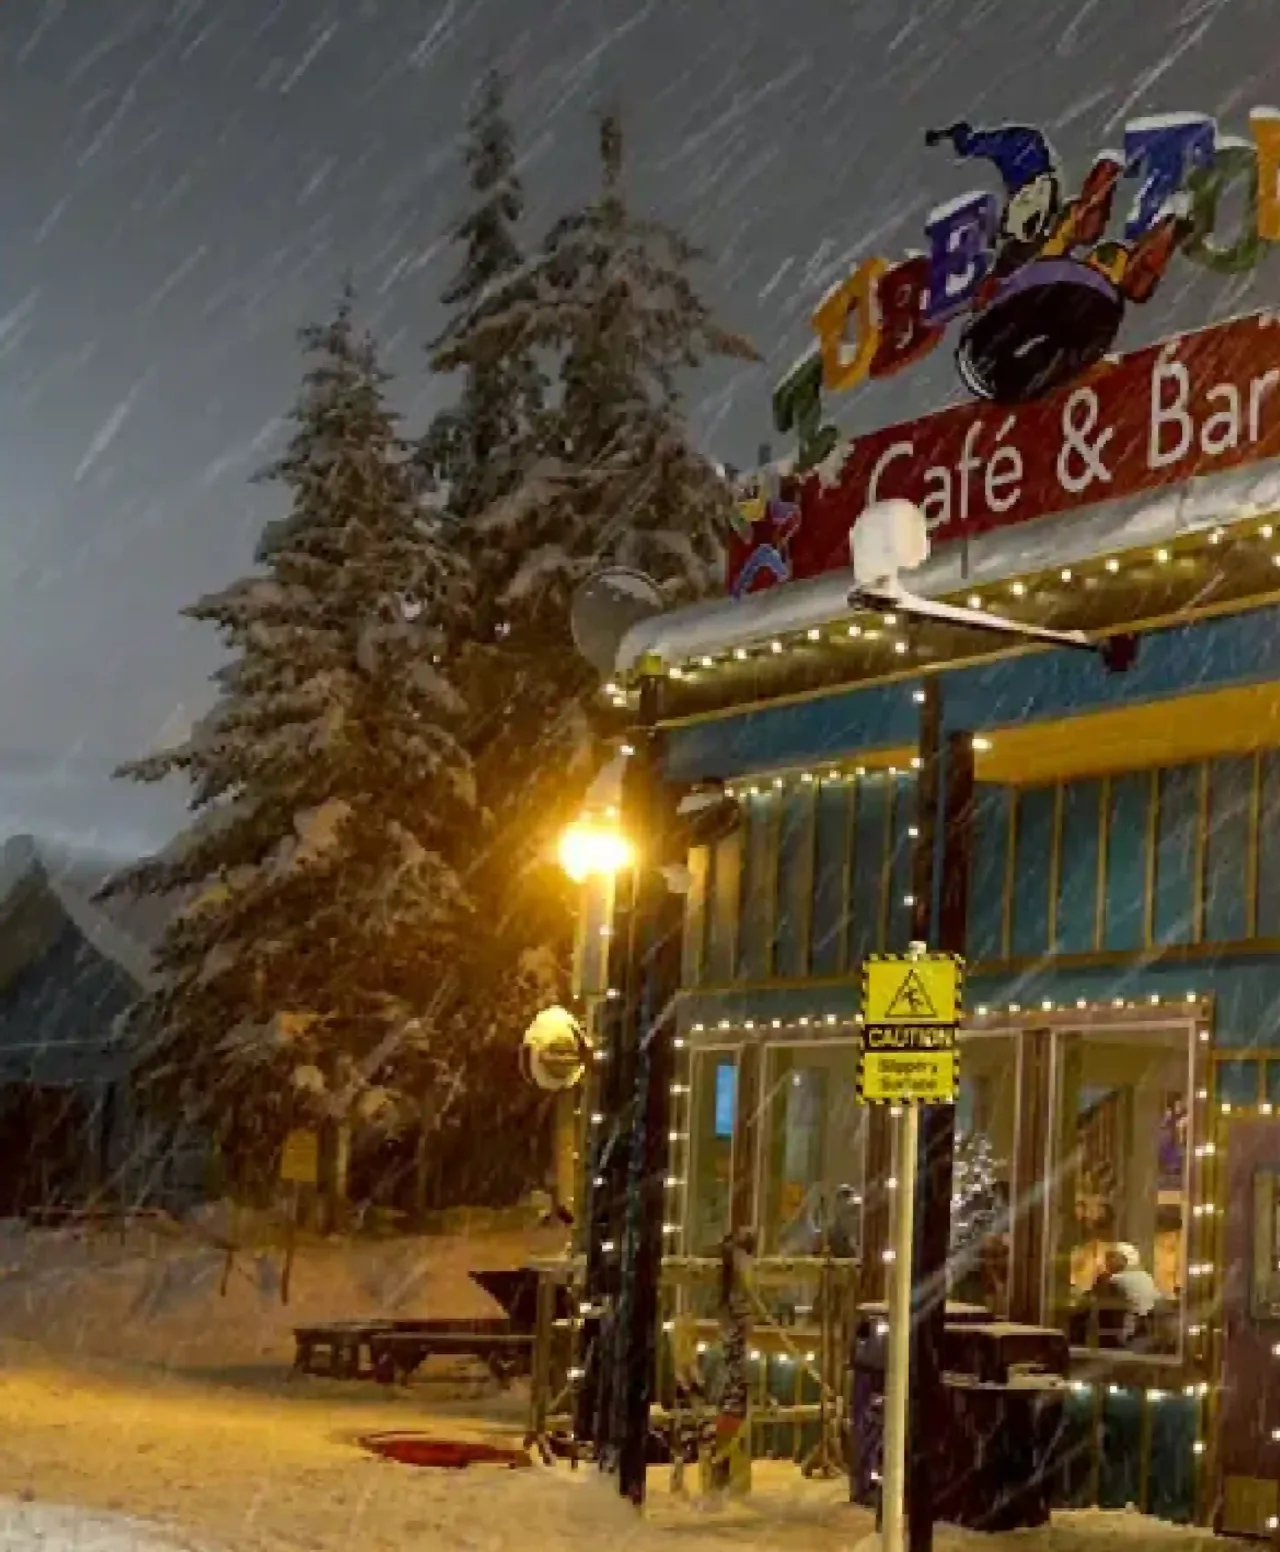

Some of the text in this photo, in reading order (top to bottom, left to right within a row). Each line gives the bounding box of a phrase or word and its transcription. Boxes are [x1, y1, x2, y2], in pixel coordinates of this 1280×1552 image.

[772, 192, 1003, 476] TUBE
[867, 415, 1024, 532] Café
[1056, 386, 1114, 493] &
[868, 1027, 953, 1048] CAUTION
